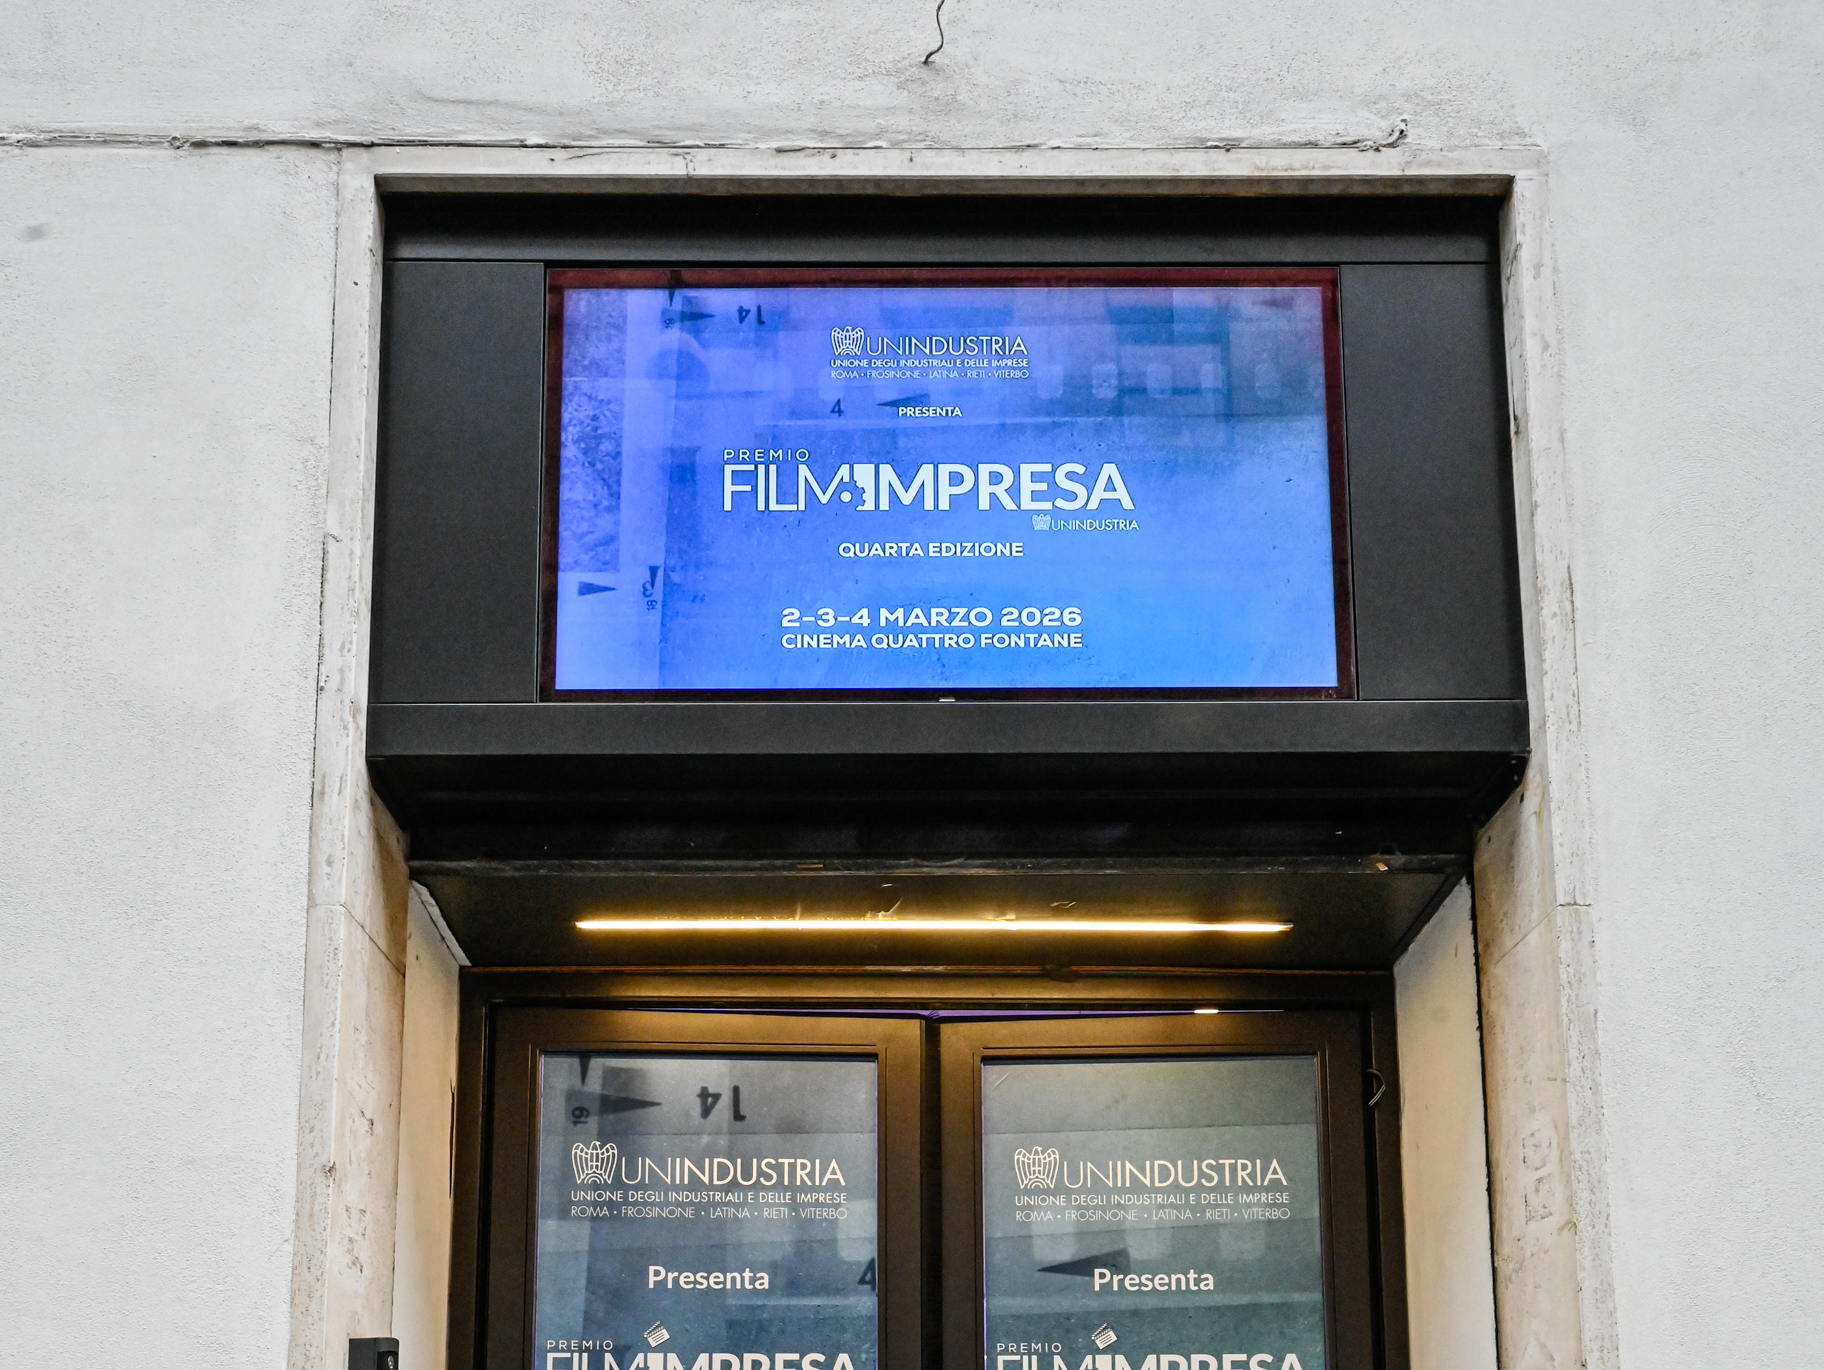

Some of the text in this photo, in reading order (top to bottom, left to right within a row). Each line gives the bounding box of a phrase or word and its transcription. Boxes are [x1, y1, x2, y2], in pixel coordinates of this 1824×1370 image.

[866, 335, 1028, 356] UNINDUSTRIA
[831, 358, 1029, 368] UNIONE DEGLI INDUSTRIALI E DELLE IMPRESE
[831, 369, 1030, 379] ROMA FROSINONE LATINA RIETI VITERBO
[898, 406, 963, 417] PRESENTA
[723, 448, 810, 462] PREMIO
[1051, 518, 1140, 532] UNINDUSTRIA
[838, 541, 1024, 558] QUARTA EDIZIONE
[781, 606, 1083, 628] 2-3-4 MARZO 2026
[781, 633, 1083, 650] CINEMA QUATTRO FONTANE
[621, 1156, 846, 1187] UNINDUSTRIA
[1063, 1159, 1288, 1189] UNINDUSTRIA
[571, 1190, 848, 1204] UNIONE DEGLI INDUSTRIALI E DELLE IMPRESE
[1015, 1192, 1289, 1206] UNIONE DEGLI INDUSTRIALI E DELLE IMPRESE
[571, 1205, 848, 1220] ROMA FROSINONE LATINA RIETI VITERBO
[1015, 1207, 1291, 1222] ROMA FROSINONE LATINA RIETI VITERBO
[647, 1265, 770, 1290] Presenta
[1093, 1268, 1215, 1292] Presenta
[547, 1339, 613, 1350] PREMIO
[997, 1342, 1062, 1353] PREMIO
